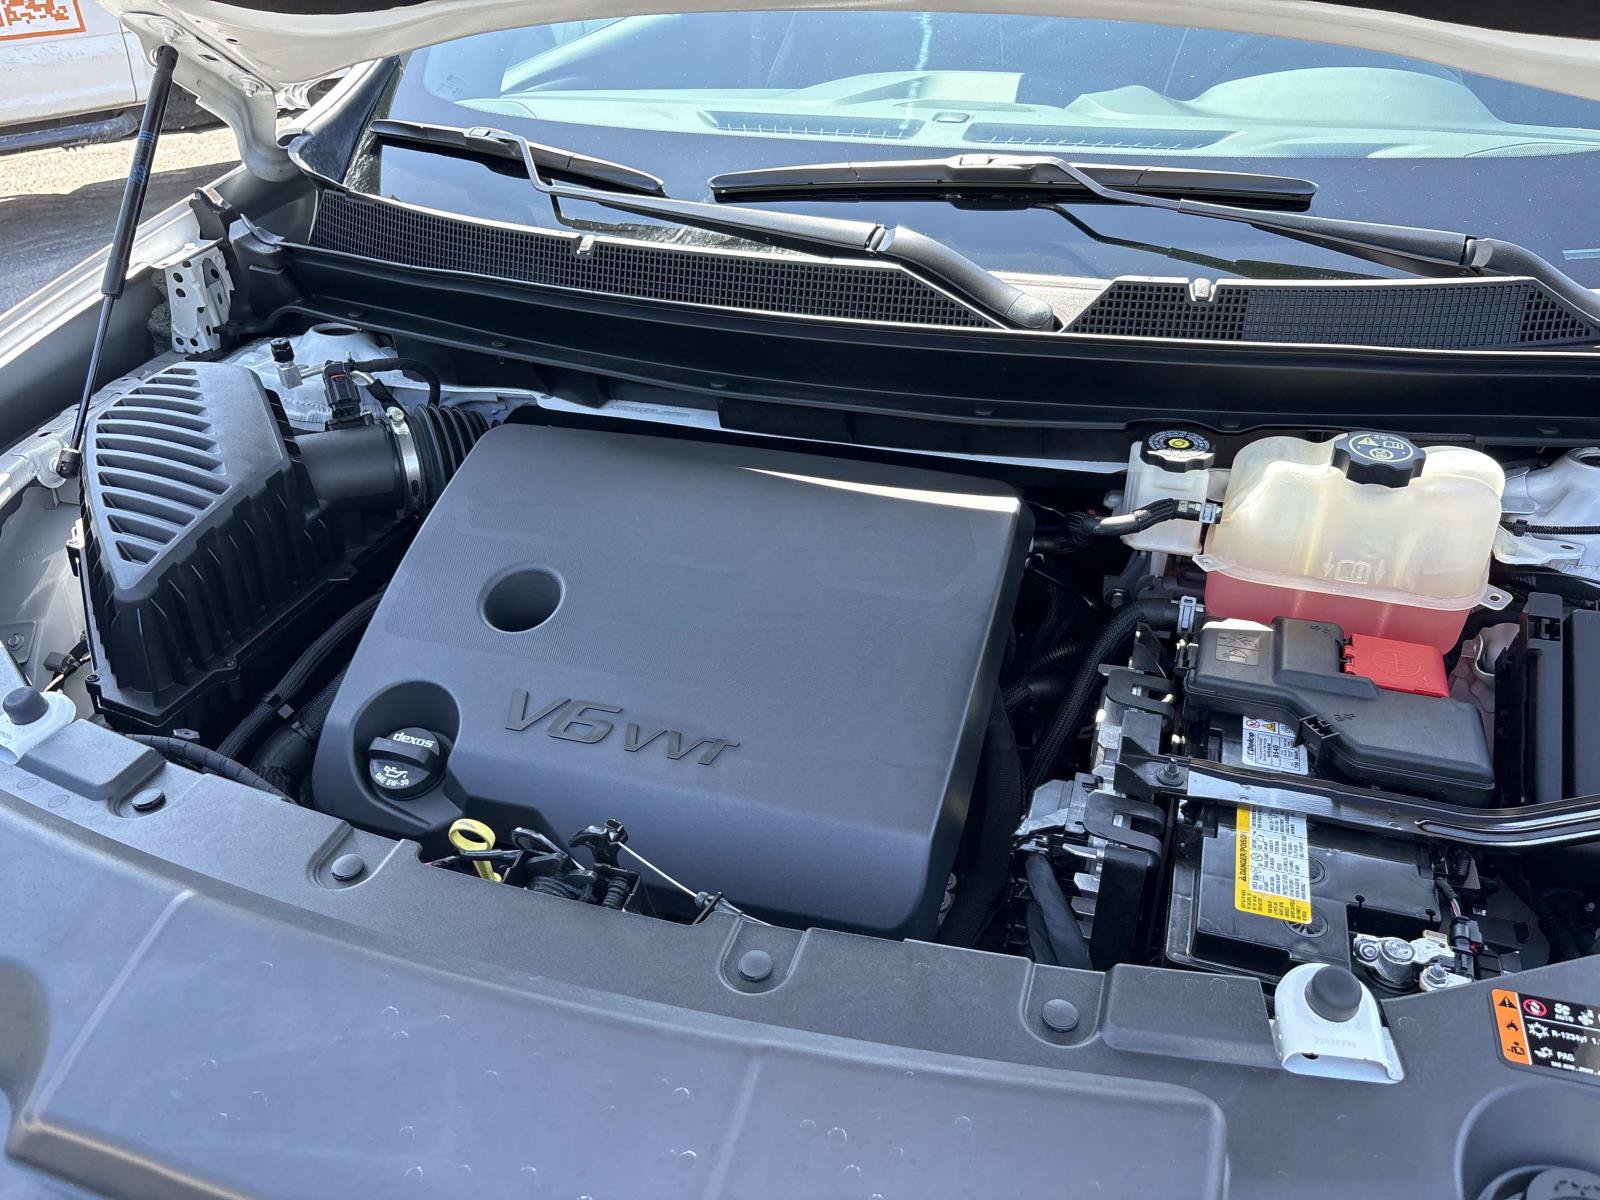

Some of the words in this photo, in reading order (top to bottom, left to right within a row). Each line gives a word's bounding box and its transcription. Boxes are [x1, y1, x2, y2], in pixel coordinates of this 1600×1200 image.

[505, 688, 624, 744] V6
[624, 723, 741, 766] VVT
[392, 732, 436, 748] dexos
[374, 772, 386, 784] SAE
[386, 779, 410, 787] 5W-30
[1555, 1014, 1574, 1023] AUTO
